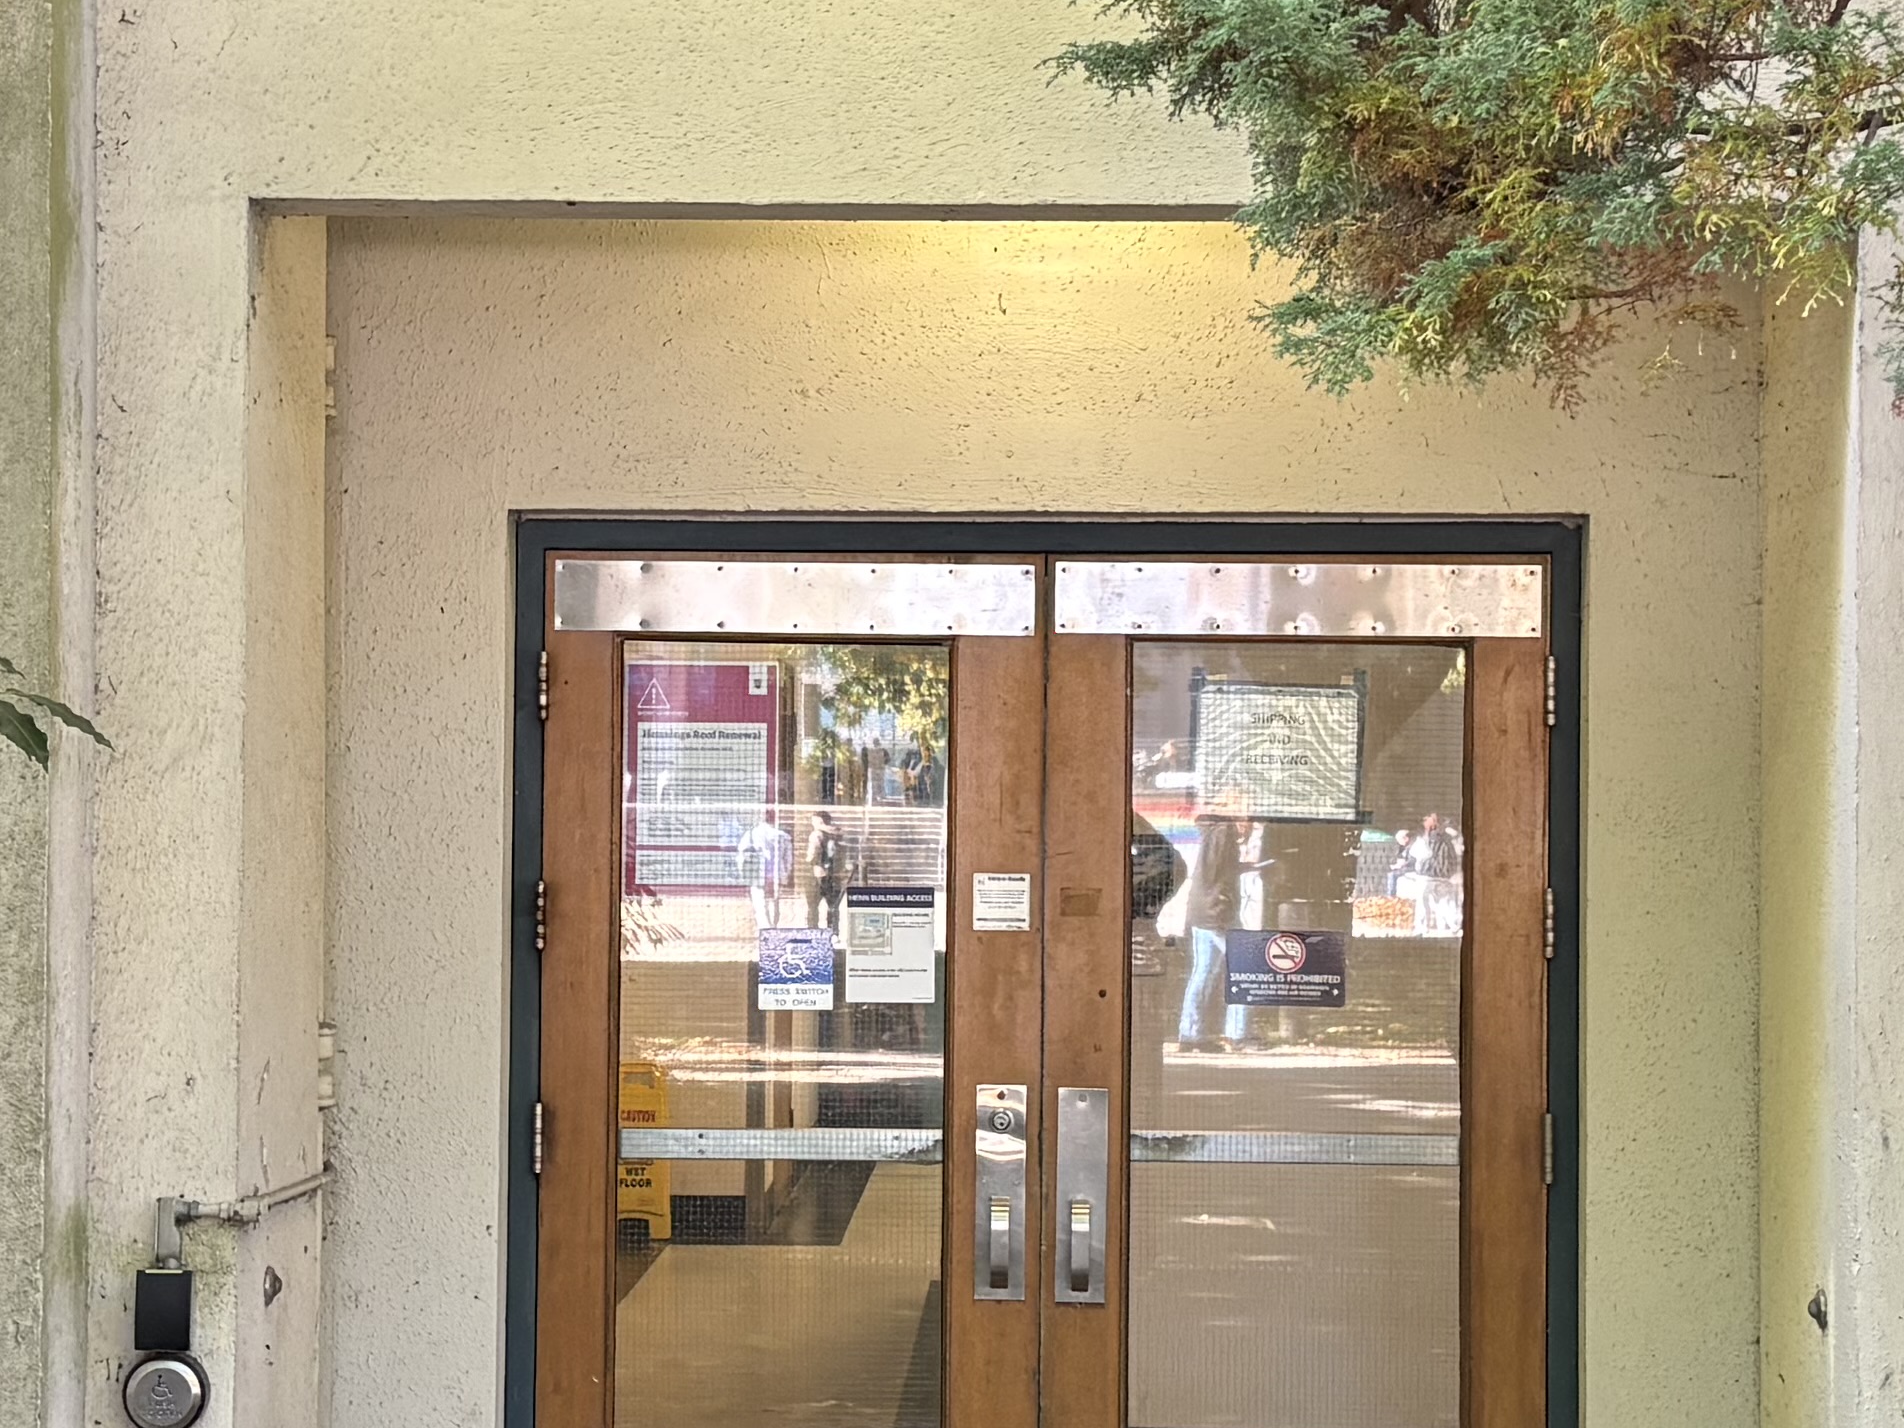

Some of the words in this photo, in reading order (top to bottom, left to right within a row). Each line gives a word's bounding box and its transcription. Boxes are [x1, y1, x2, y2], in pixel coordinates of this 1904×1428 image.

[1250, 712, 1306, 725] SHIPPING
[1245, 754, 1310, 766] RECEIVING
[870, 894, 905, 902] BUILDING
[906, 894, 933, 902] ACCESS
[1229, 973, 1274, 983] SMOKING
[1276, 973, 1285, 983] IS
[1287, 974, 1341, 984] PROHIBITED
[624, 1167, 647, 1176] WET
[619, 1178, 652, 1188] FLOOR
